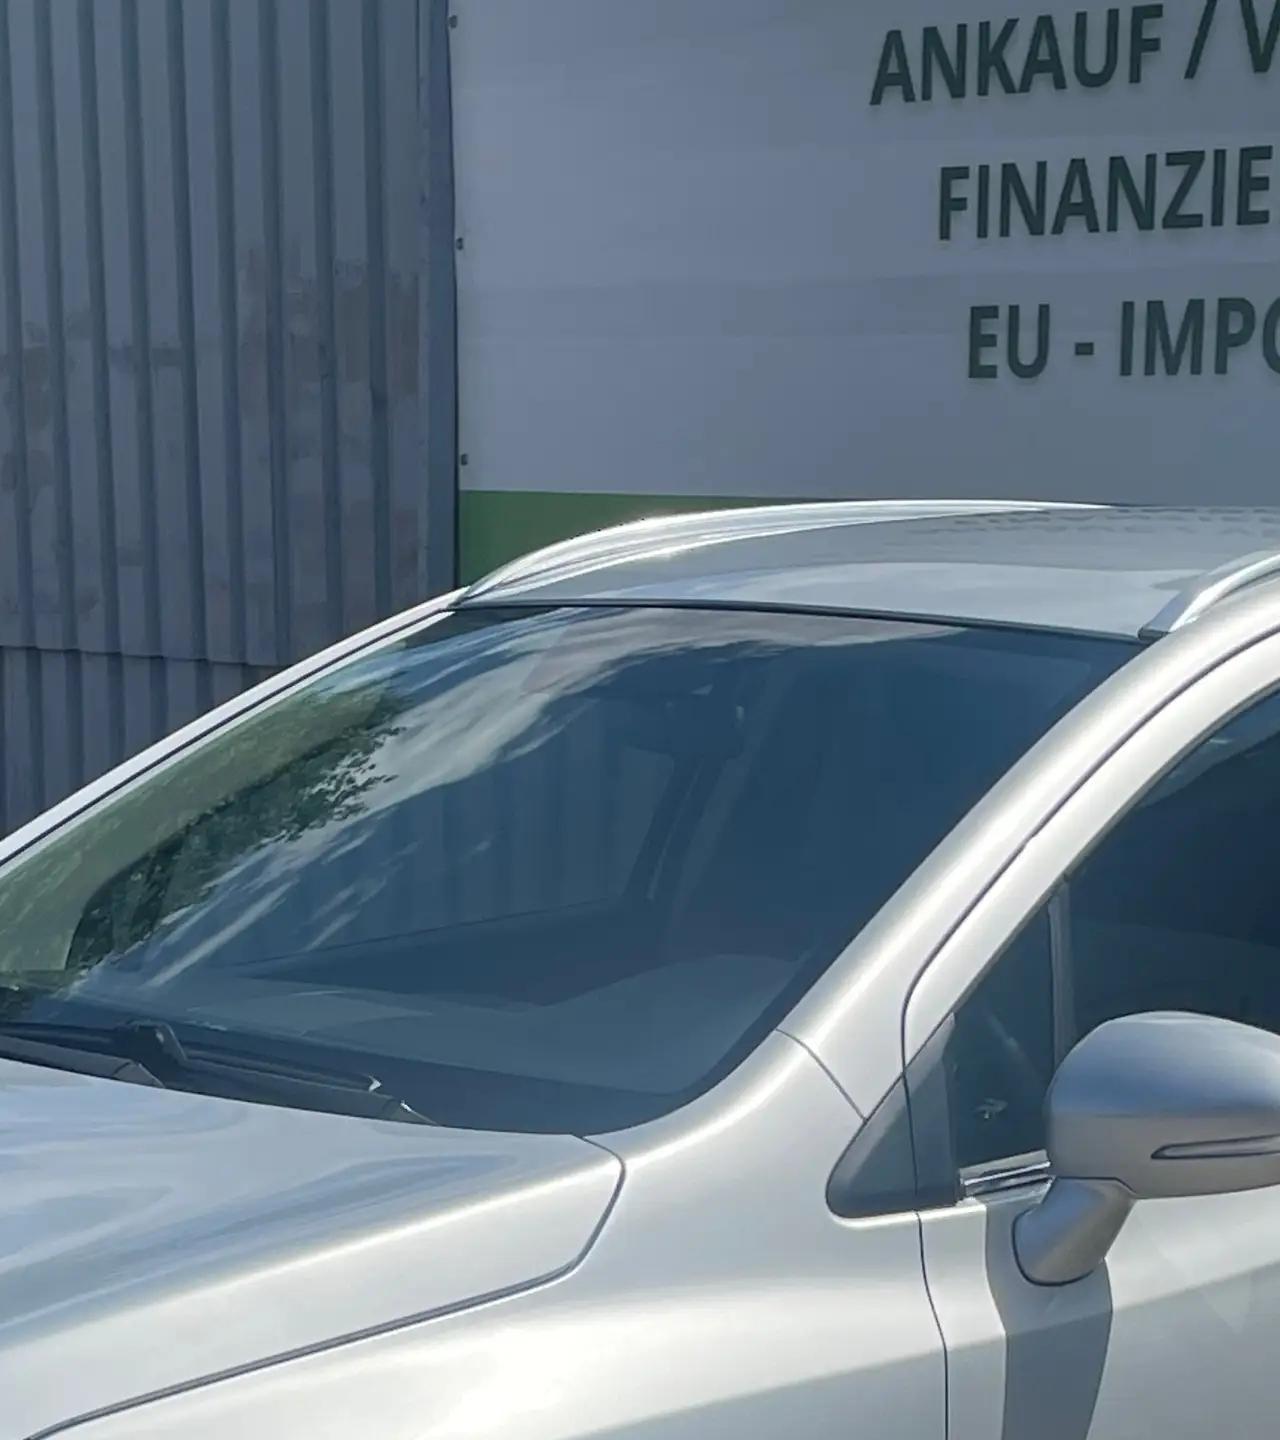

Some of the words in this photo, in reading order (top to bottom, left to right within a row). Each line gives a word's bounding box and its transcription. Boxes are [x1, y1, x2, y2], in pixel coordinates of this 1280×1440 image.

[869, 4, 1164, 106] ANKAUF
[1183, 0, 1217, 80] /
[966, 303, 1052, 380] EU
